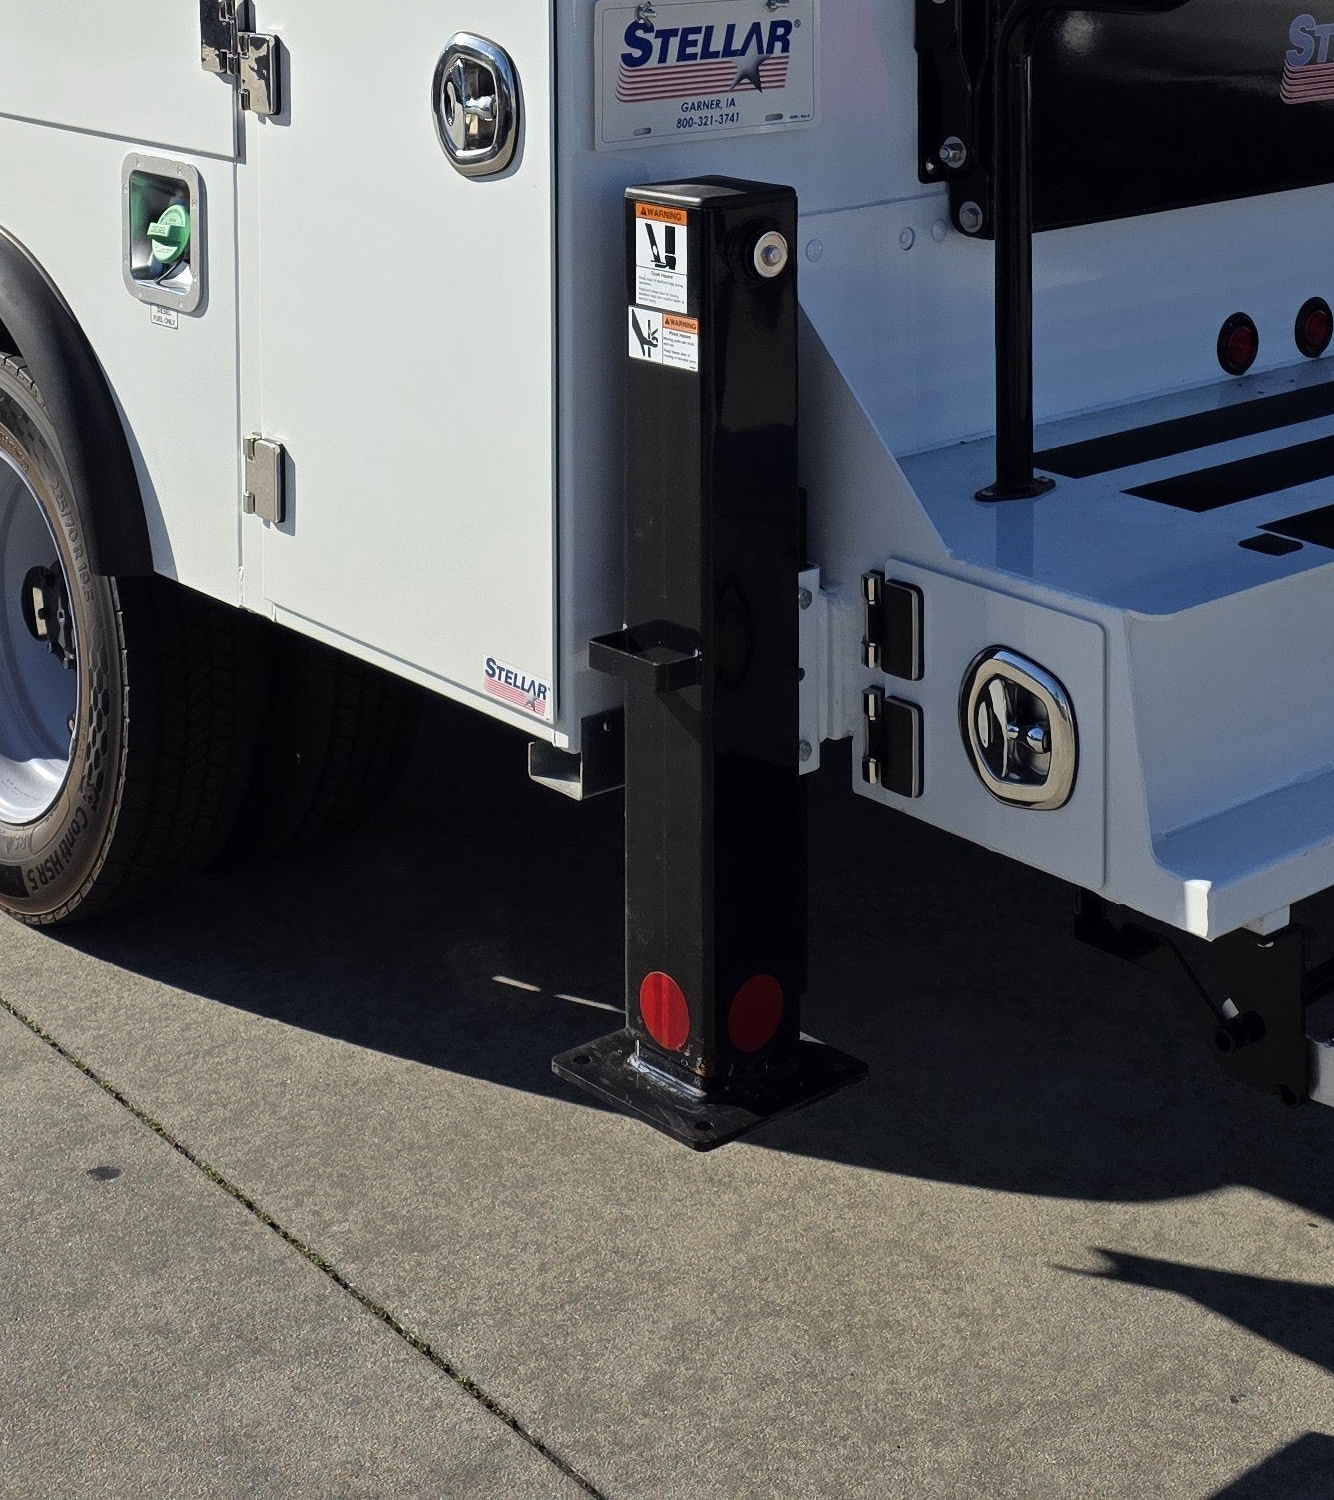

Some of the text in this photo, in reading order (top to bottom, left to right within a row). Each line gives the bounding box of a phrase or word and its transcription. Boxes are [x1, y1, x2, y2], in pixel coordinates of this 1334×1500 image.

[620, 20, 793, 68] STELLAR
[680, 98, 736, 113] GARNER, IA
[676, 112, 740, 129] 800-321-3741
[646, 207, 682, 222] WARNING
[669, 318, 697, 330] WARNING
[485, 657, 548, 701] STELLAR
